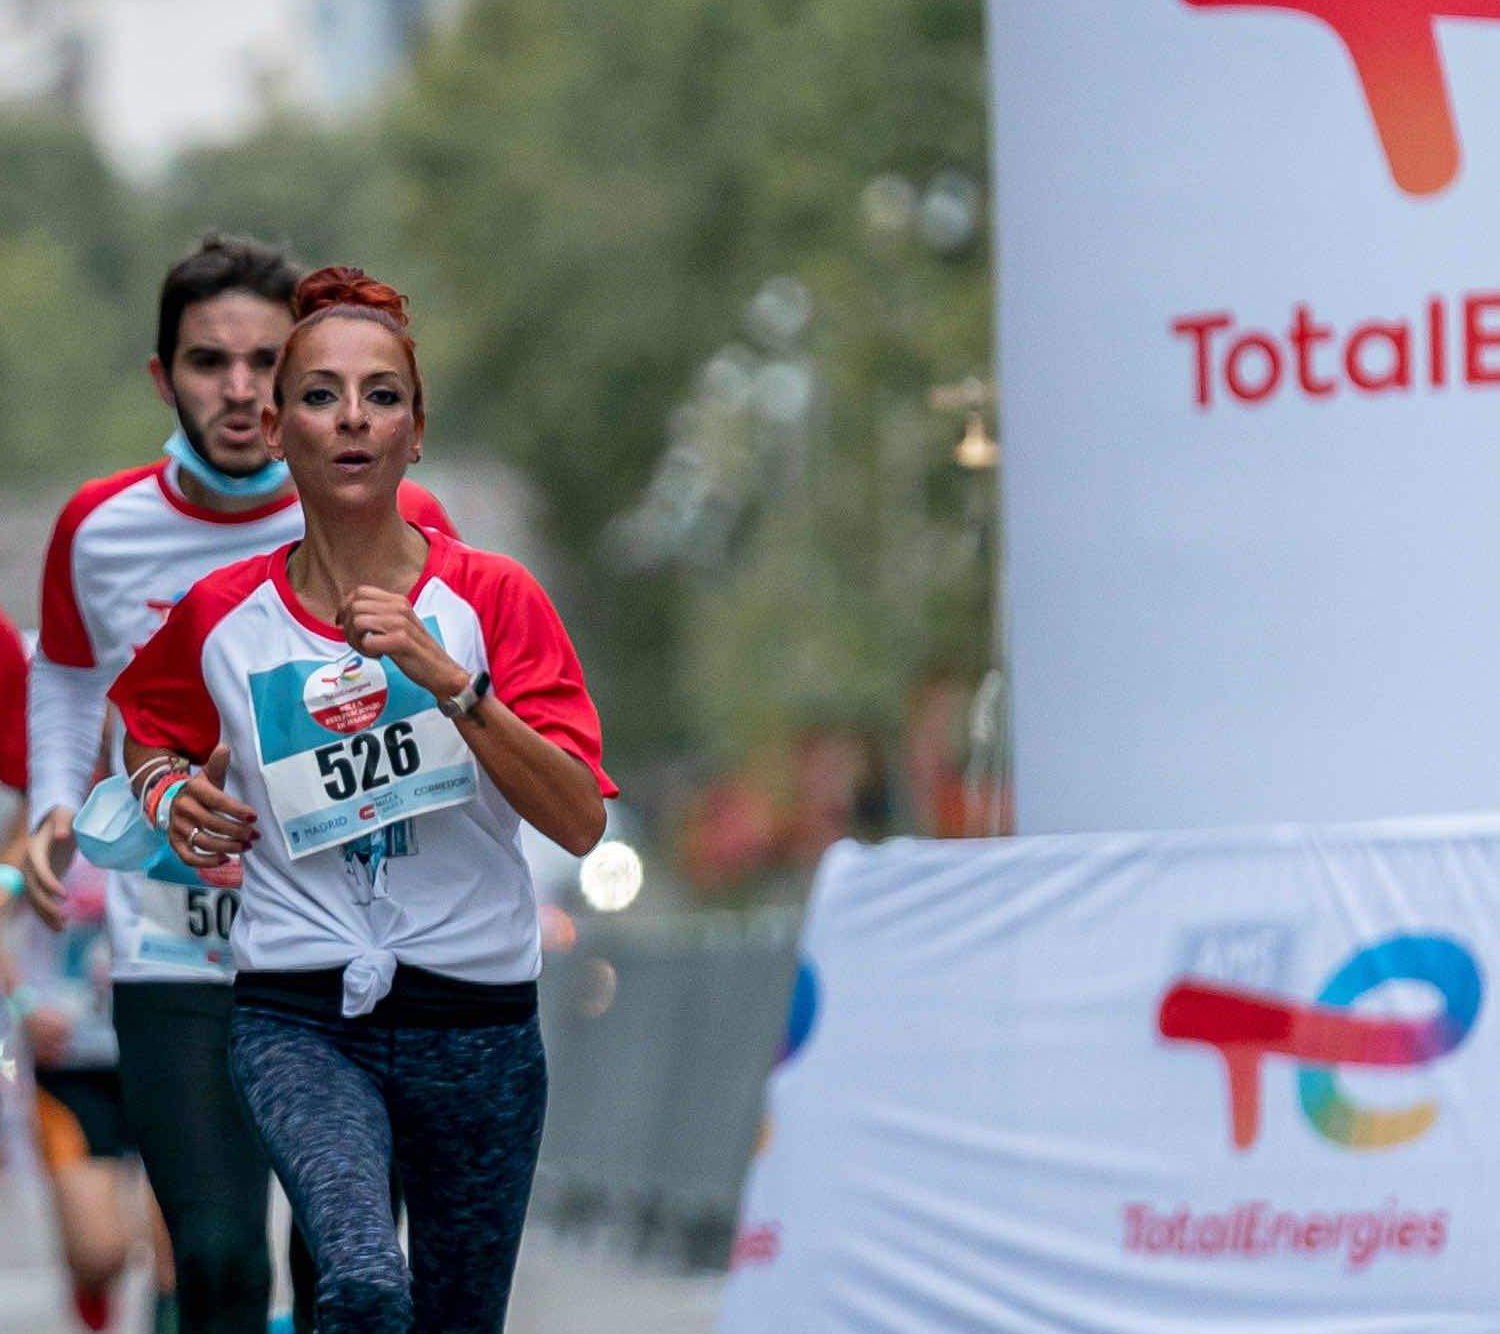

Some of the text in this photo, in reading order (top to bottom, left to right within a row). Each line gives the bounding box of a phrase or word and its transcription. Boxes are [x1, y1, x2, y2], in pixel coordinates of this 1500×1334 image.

[315, 721, 420, 801] 526
[304, 816, 348, 838] MADRID
[1123, 1197, 1451, 1272] TotalEnergies
